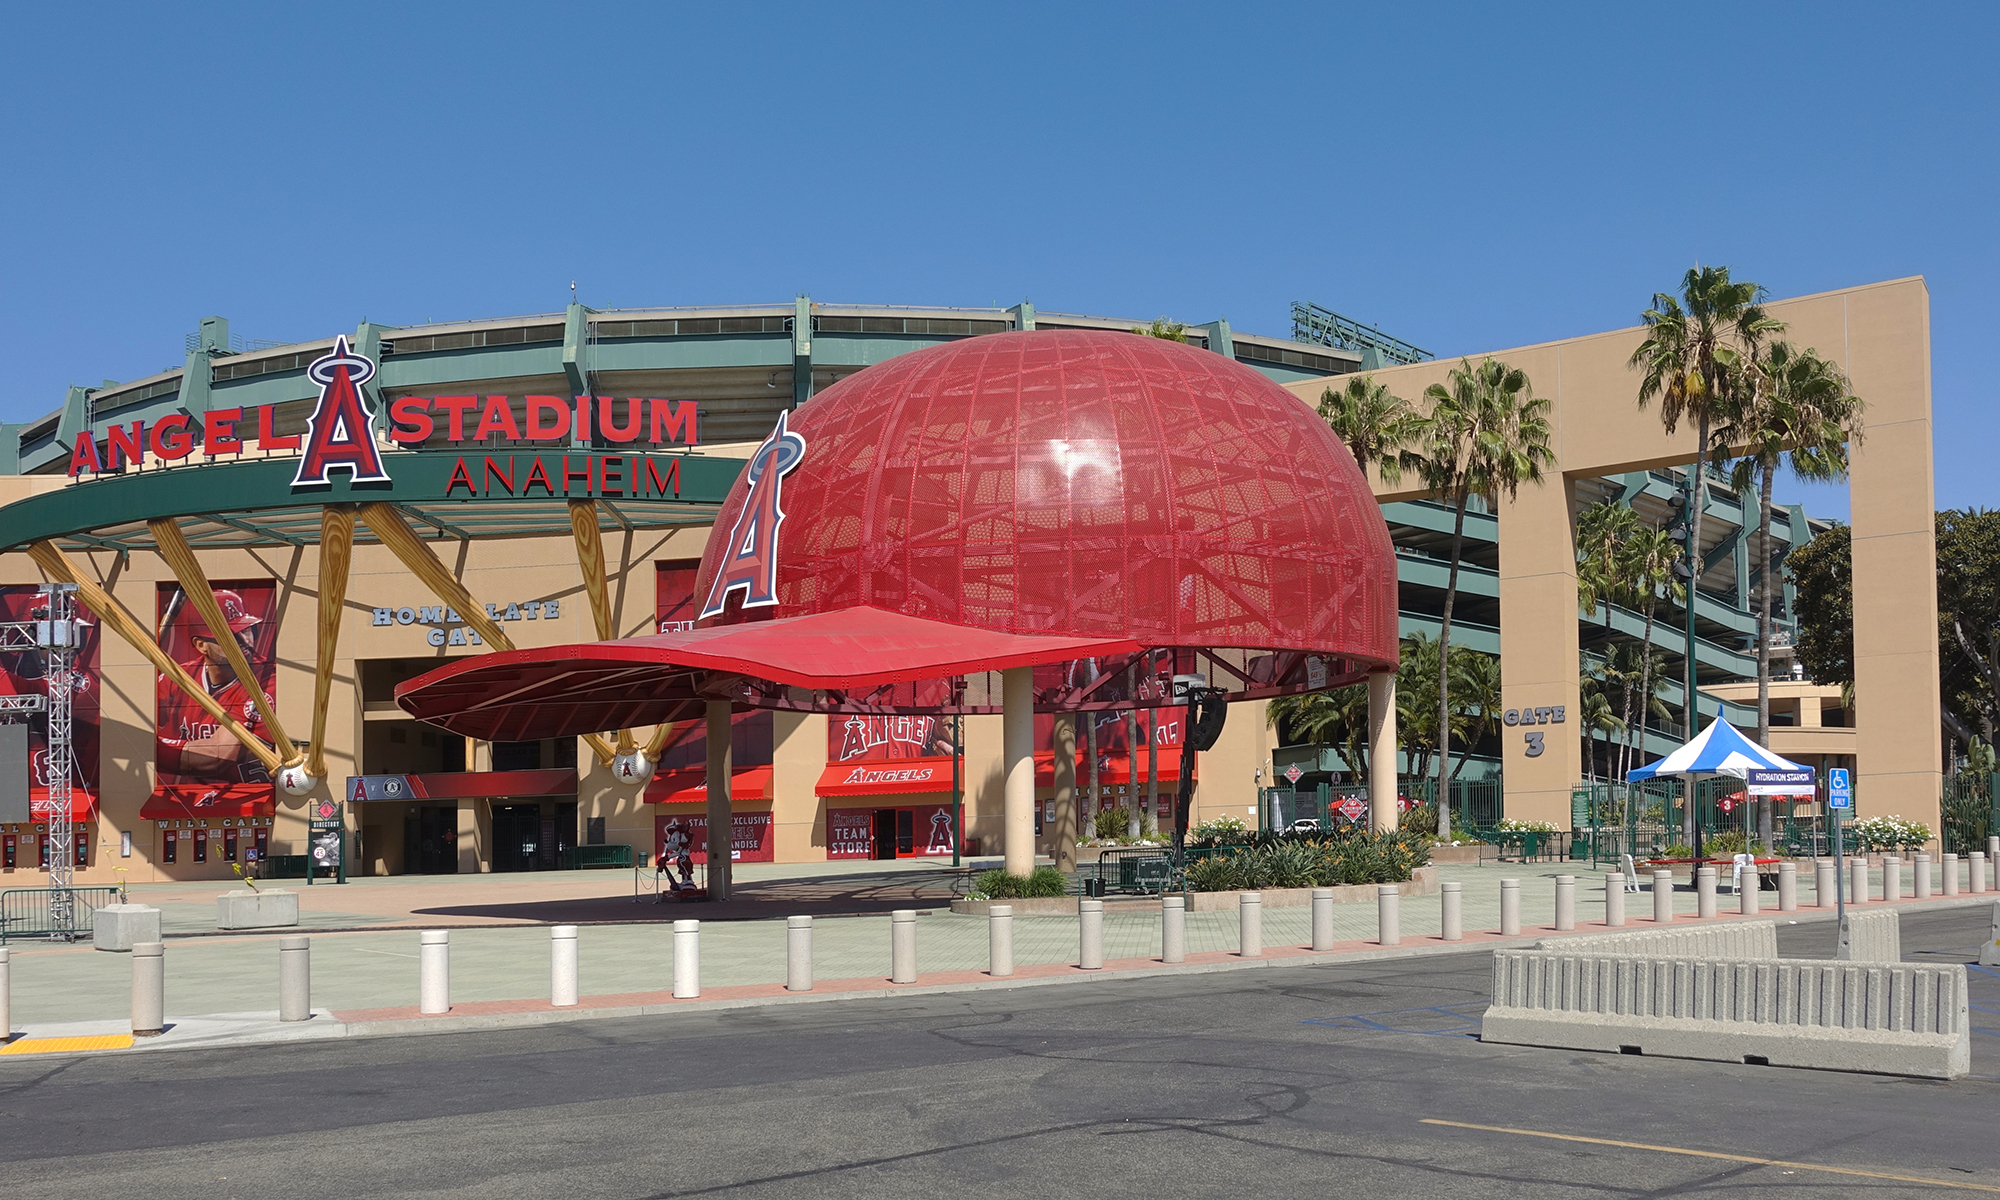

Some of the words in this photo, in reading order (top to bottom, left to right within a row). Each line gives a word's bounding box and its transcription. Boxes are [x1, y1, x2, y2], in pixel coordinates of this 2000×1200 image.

[68, 404, 301, 477] ANGEL
[389, 394, 698, 445] STADIUM
[446, 455, 680, 495] ANAHEIM
[485, 600, 560, 621] LATE
[427, 625, 504, 647] GAT
[1503, 705, 1566, 726] GATE
[1524, 731, 1546, 758] 3
[843, 766, 933, 784] ANGELS
[1755, 772, 1787, 782] HYDRATION
[1830, 789, 1849, 797] PARKING
[1723, 800, 1731, 811] 3
[1833, 797, 1846, 806] ONLY
[158, 819, 208, 829] WILL
[222, 817, 273, 827] CALL
[834, 828, 867, 840] TEAM
[831, 842, 871, 854] STORE
